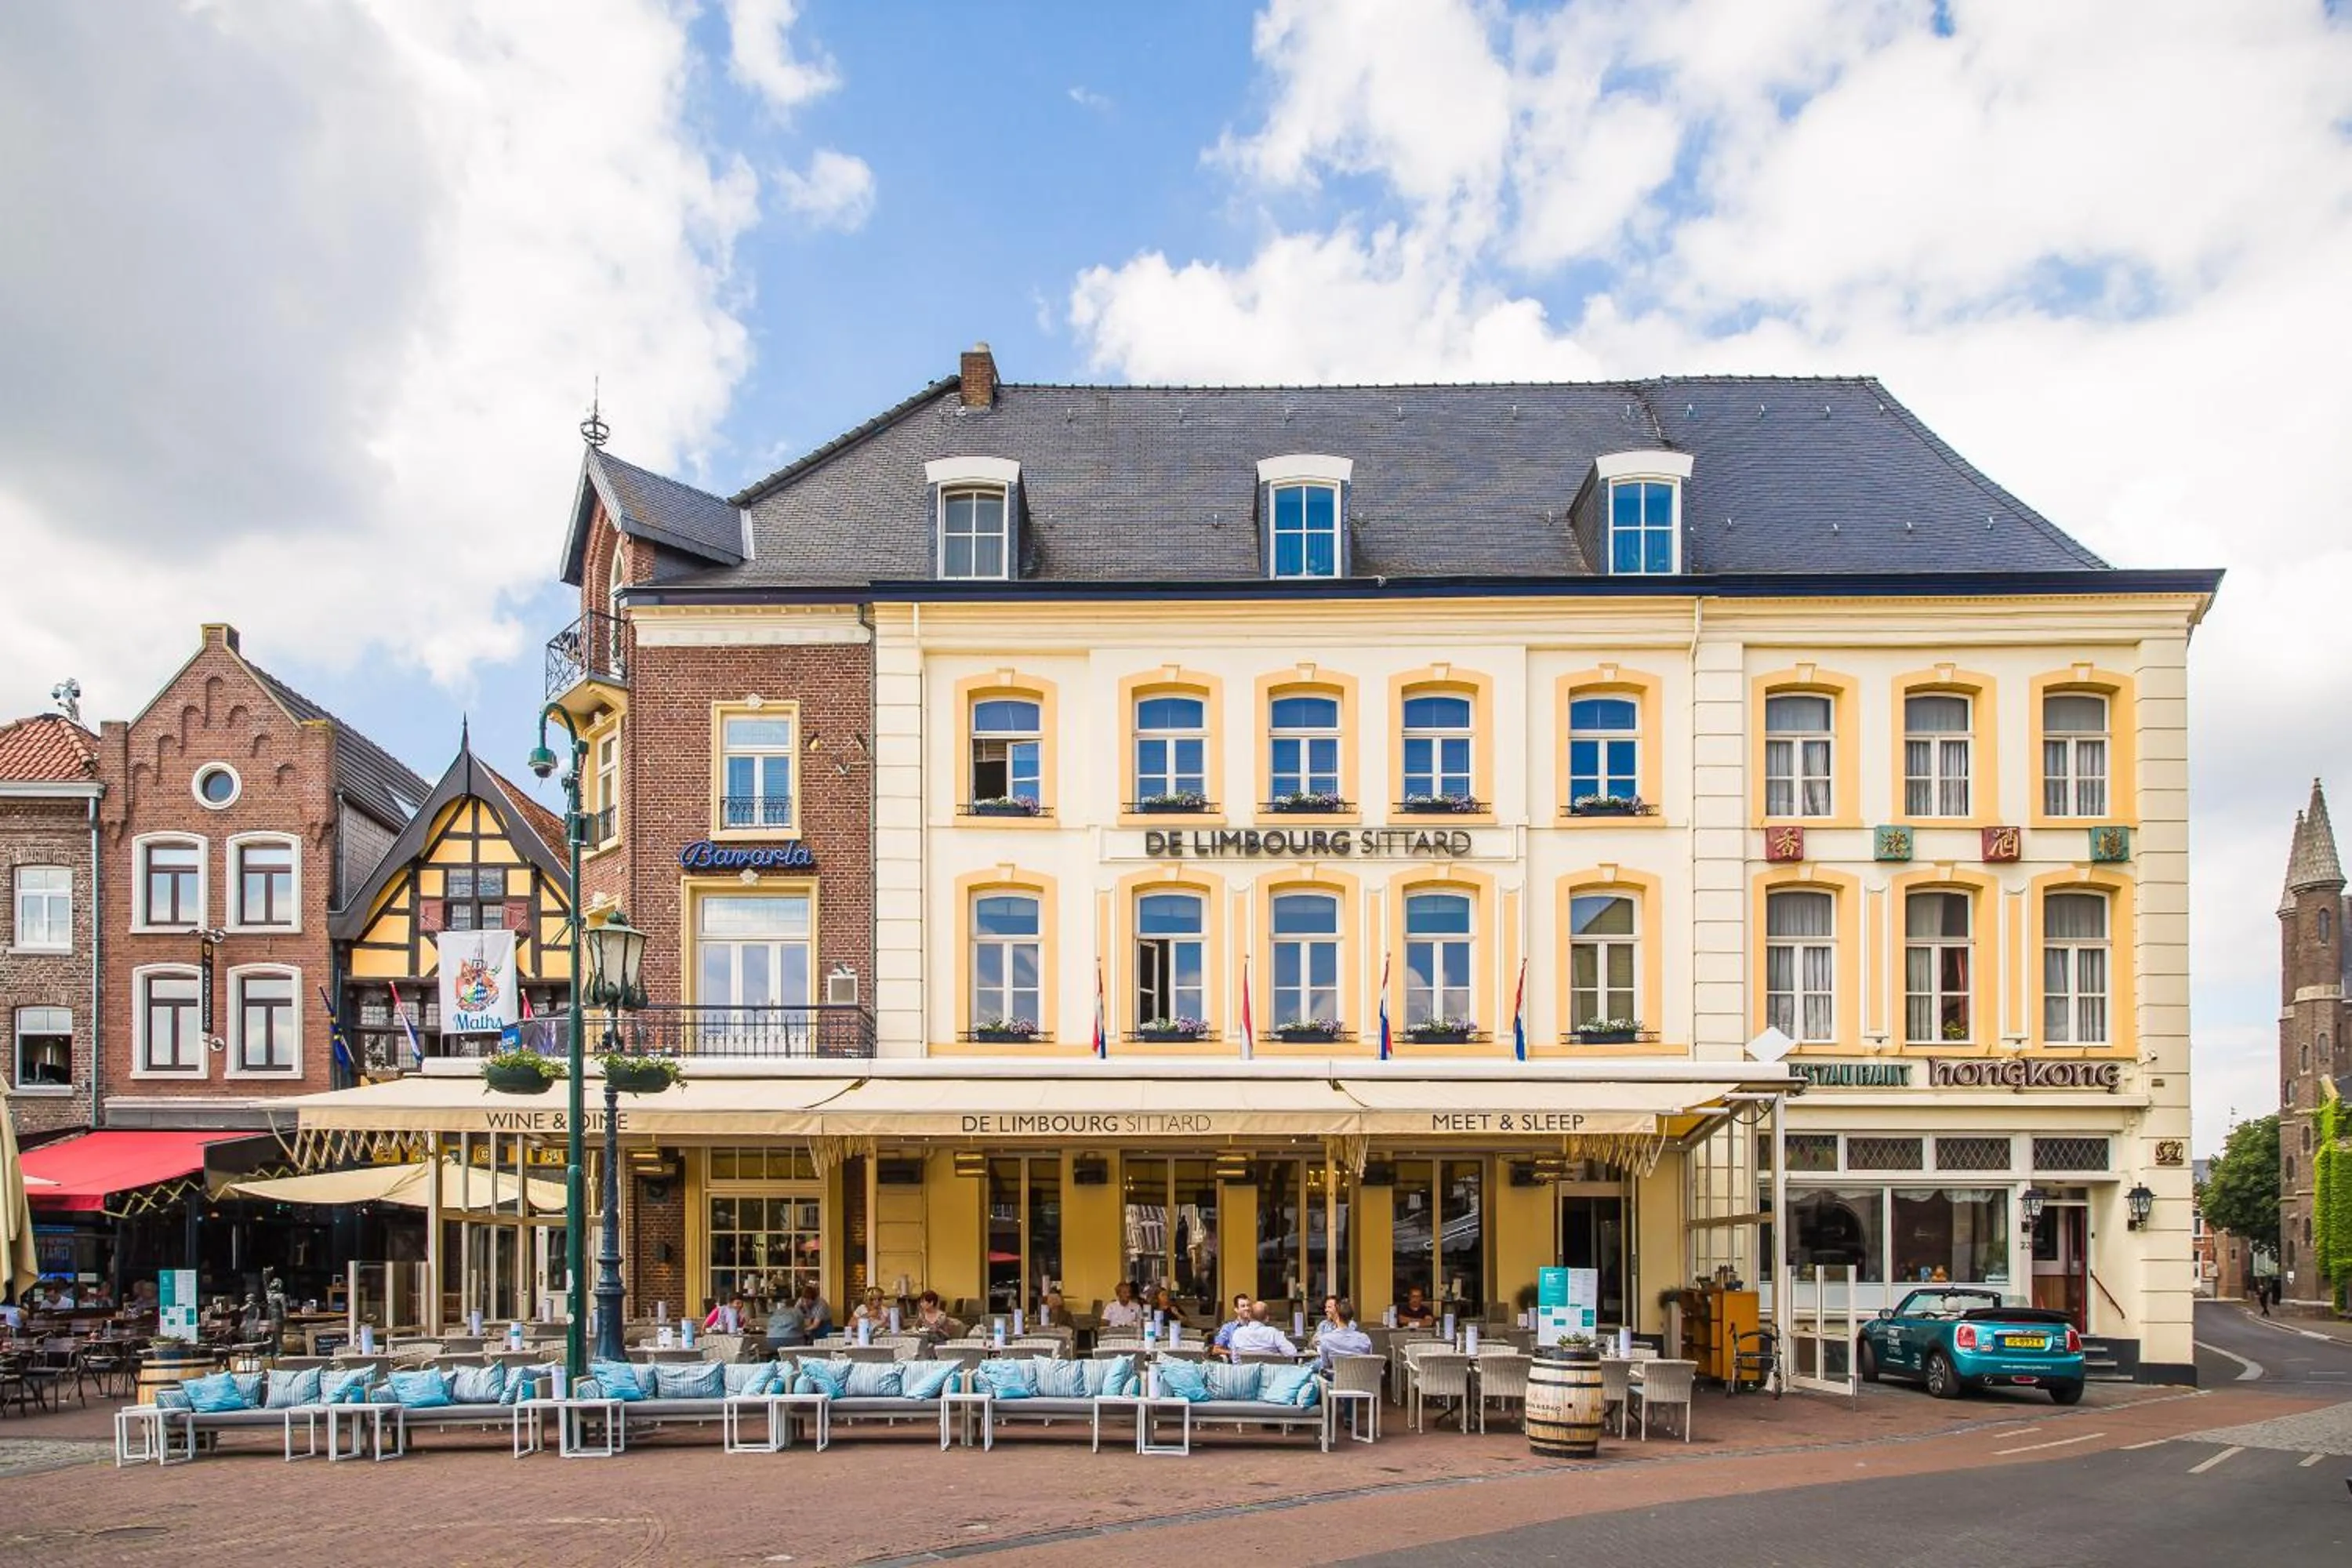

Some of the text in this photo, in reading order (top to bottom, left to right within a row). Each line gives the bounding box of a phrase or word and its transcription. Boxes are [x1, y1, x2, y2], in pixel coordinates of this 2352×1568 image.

[1145, 831, 1472, 856] DE LIMBOURG SITTARD
[680, 840, 814, 869] Bavaria
[453, 1013, 503, 1030] Maths
[1789, 1064, 1912, 1087] ESTAURANT
[486, 1112, 545, 1129] WINE
[553, 1112, 566, 1130] &
[962, 1116, 1211, 1132] DE LIMBOURG SITTARD
[1432, 1114, 1584, 1131] MEET & SLEEP
